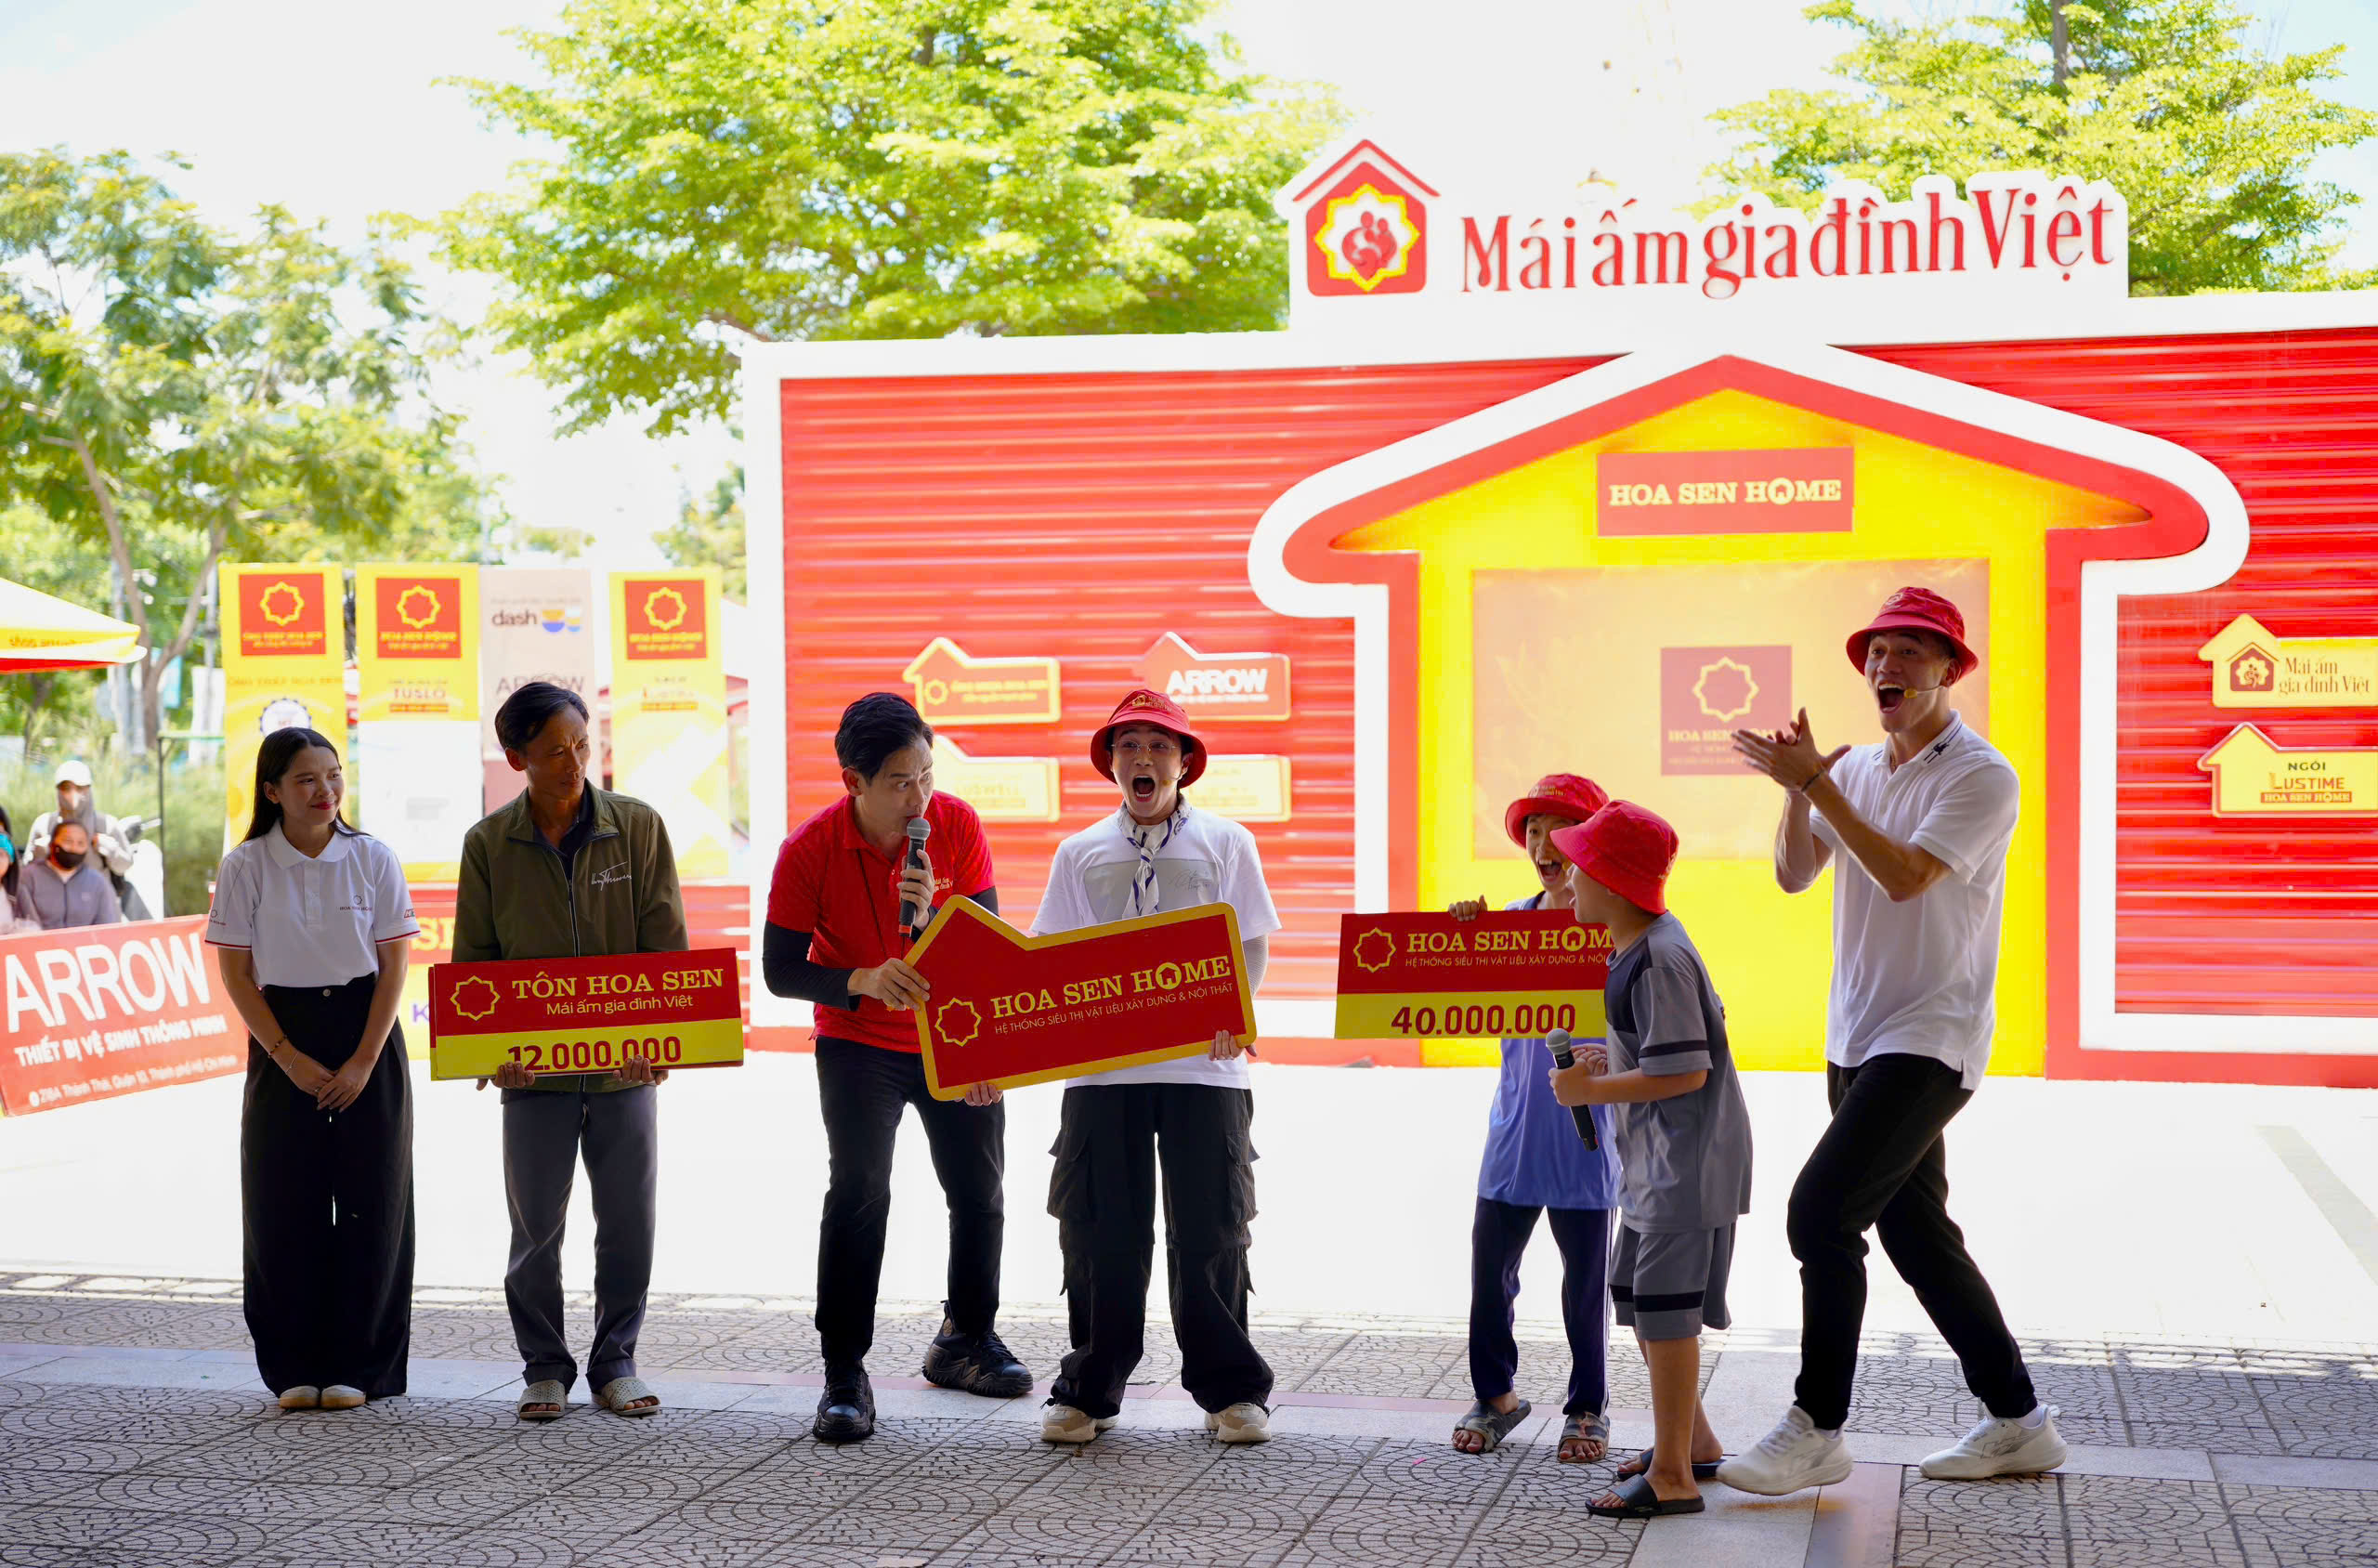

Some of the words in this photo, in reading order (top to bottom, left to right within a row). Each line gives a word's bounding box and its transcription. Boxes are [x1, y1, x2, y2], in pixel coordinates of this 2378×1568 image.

[1462, 214, 1576, 293] Mái
[1591, 196, 1688, 287] ấm
[1703, 203, 1799, 300] gia
[1809, 191, 1966, 276] đình
[1972, 186, 2115, 282] Việt
[1609, 483, 1672, 506] HOA
[1678, 481, 1738, 505] SEN
[1744, 477, 1842, 505] HOME
[491, 608, 538, 626] dash
[1167, 669, 1268, 695] ARROW
[1406, 932, 1467, 952] HOA
[1474, 931, 1531, 951] SEN
[1538, 926, 1614, 951] HOM
[1579, 954, 1586, 963] &
[5, 933, 211, 1033] ARROW
[512, 971, 577, 1000] TÔN
[586, 973, 654, 995] HOA
[662, 969, 724, 990] SEN
[990, 988, 1058, 1018] HOA
[1063, 974, 1122, 1005] SEN
[1130, 956, 1232, 993] HOME
[546, 1001, 574, 1015] Mái
[577, 999, 602, 1013] ấm
[605, 1000, 626, 1014] gia
[629, 996, 661, 1011] đình
[664, 995, 694, 1010] Việt
[995, 1023, 1009, 1035] HỆ
[1010, 1018, 1046, 1032] THỐNG
[1048, 1013, 1067, 1026] SIÊU
[1069, 1010, 1084, 1022] THỊ
[1085, 1006, 1104, 1019] VẬT
[1105, 1002, 1124, 1015] LIỆU
[1126, 999, 1143, 1011] XÂY
[1146, 994, 1176, 1007] DỰNG
[1179, 991, 1186, 1001] &
[1189, 986, 1209, 1000] NỘI
[1210, 981, 1233, 995] THẤT
[1391, 1003, 1576, 1036] 40.000.000
[14, 1034, 60, 1067] THIẾT
[80, 1029, 105, 1059] VỆ
[104, 1027, 141, 1053] SINH
[507, 1036, 682, 1071] 12.000.000
